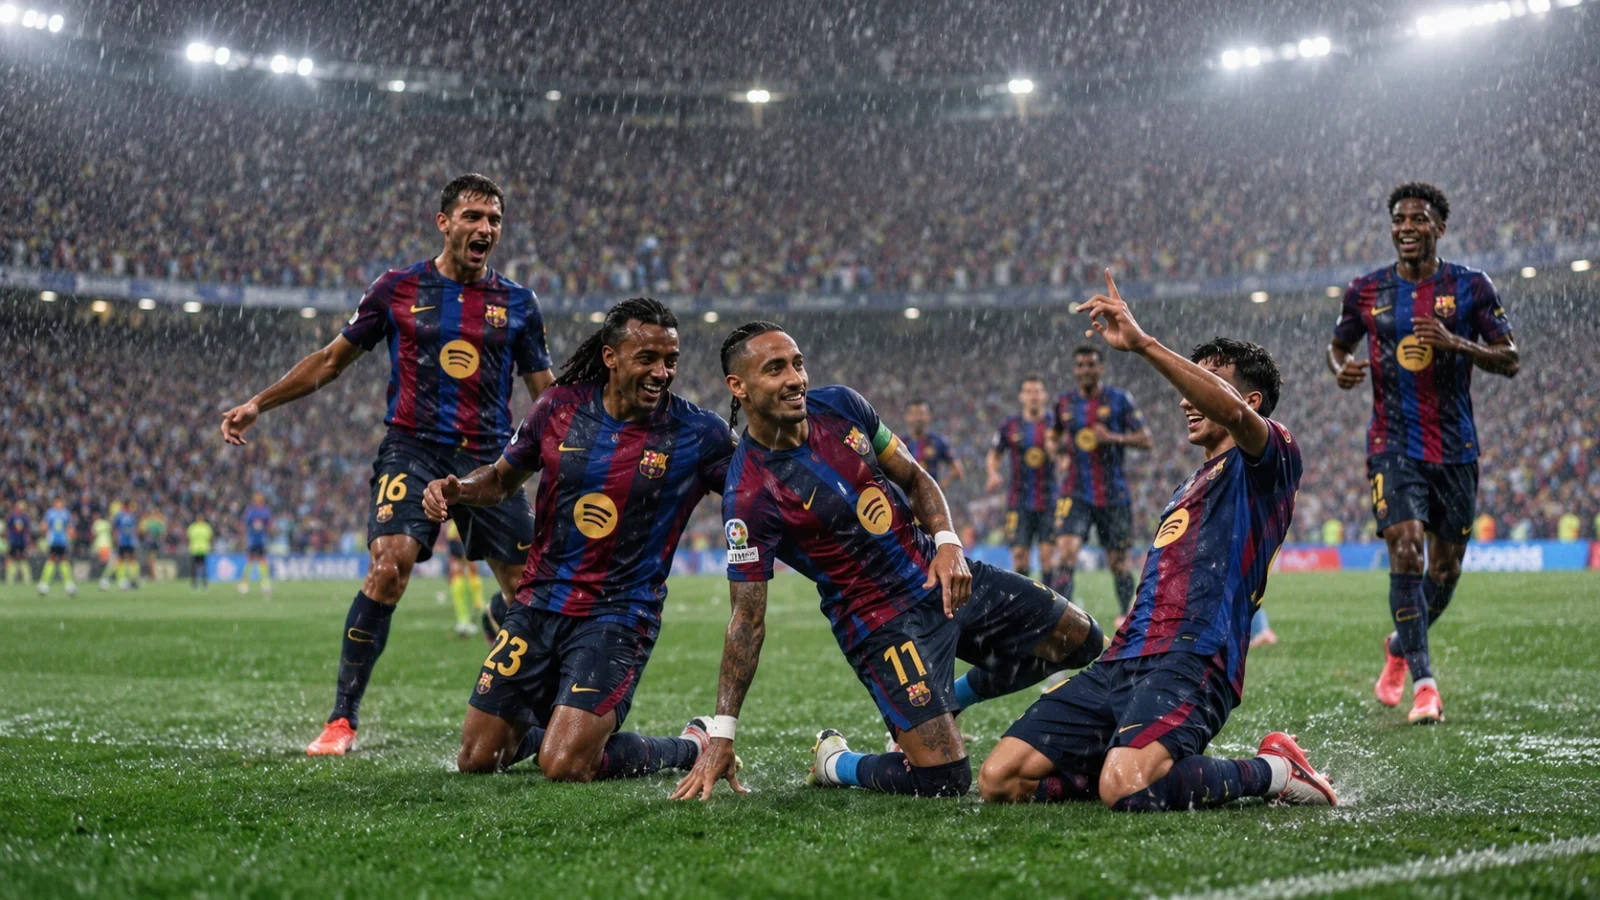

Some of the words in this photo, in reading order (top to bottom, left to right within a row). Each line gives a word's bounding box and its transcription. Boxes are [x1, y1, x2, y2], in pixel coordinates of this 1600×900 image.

[376, 472, 408, 506] 16
[483, 629, 529, 677] 23
[883, 640, 927, 686] 11
